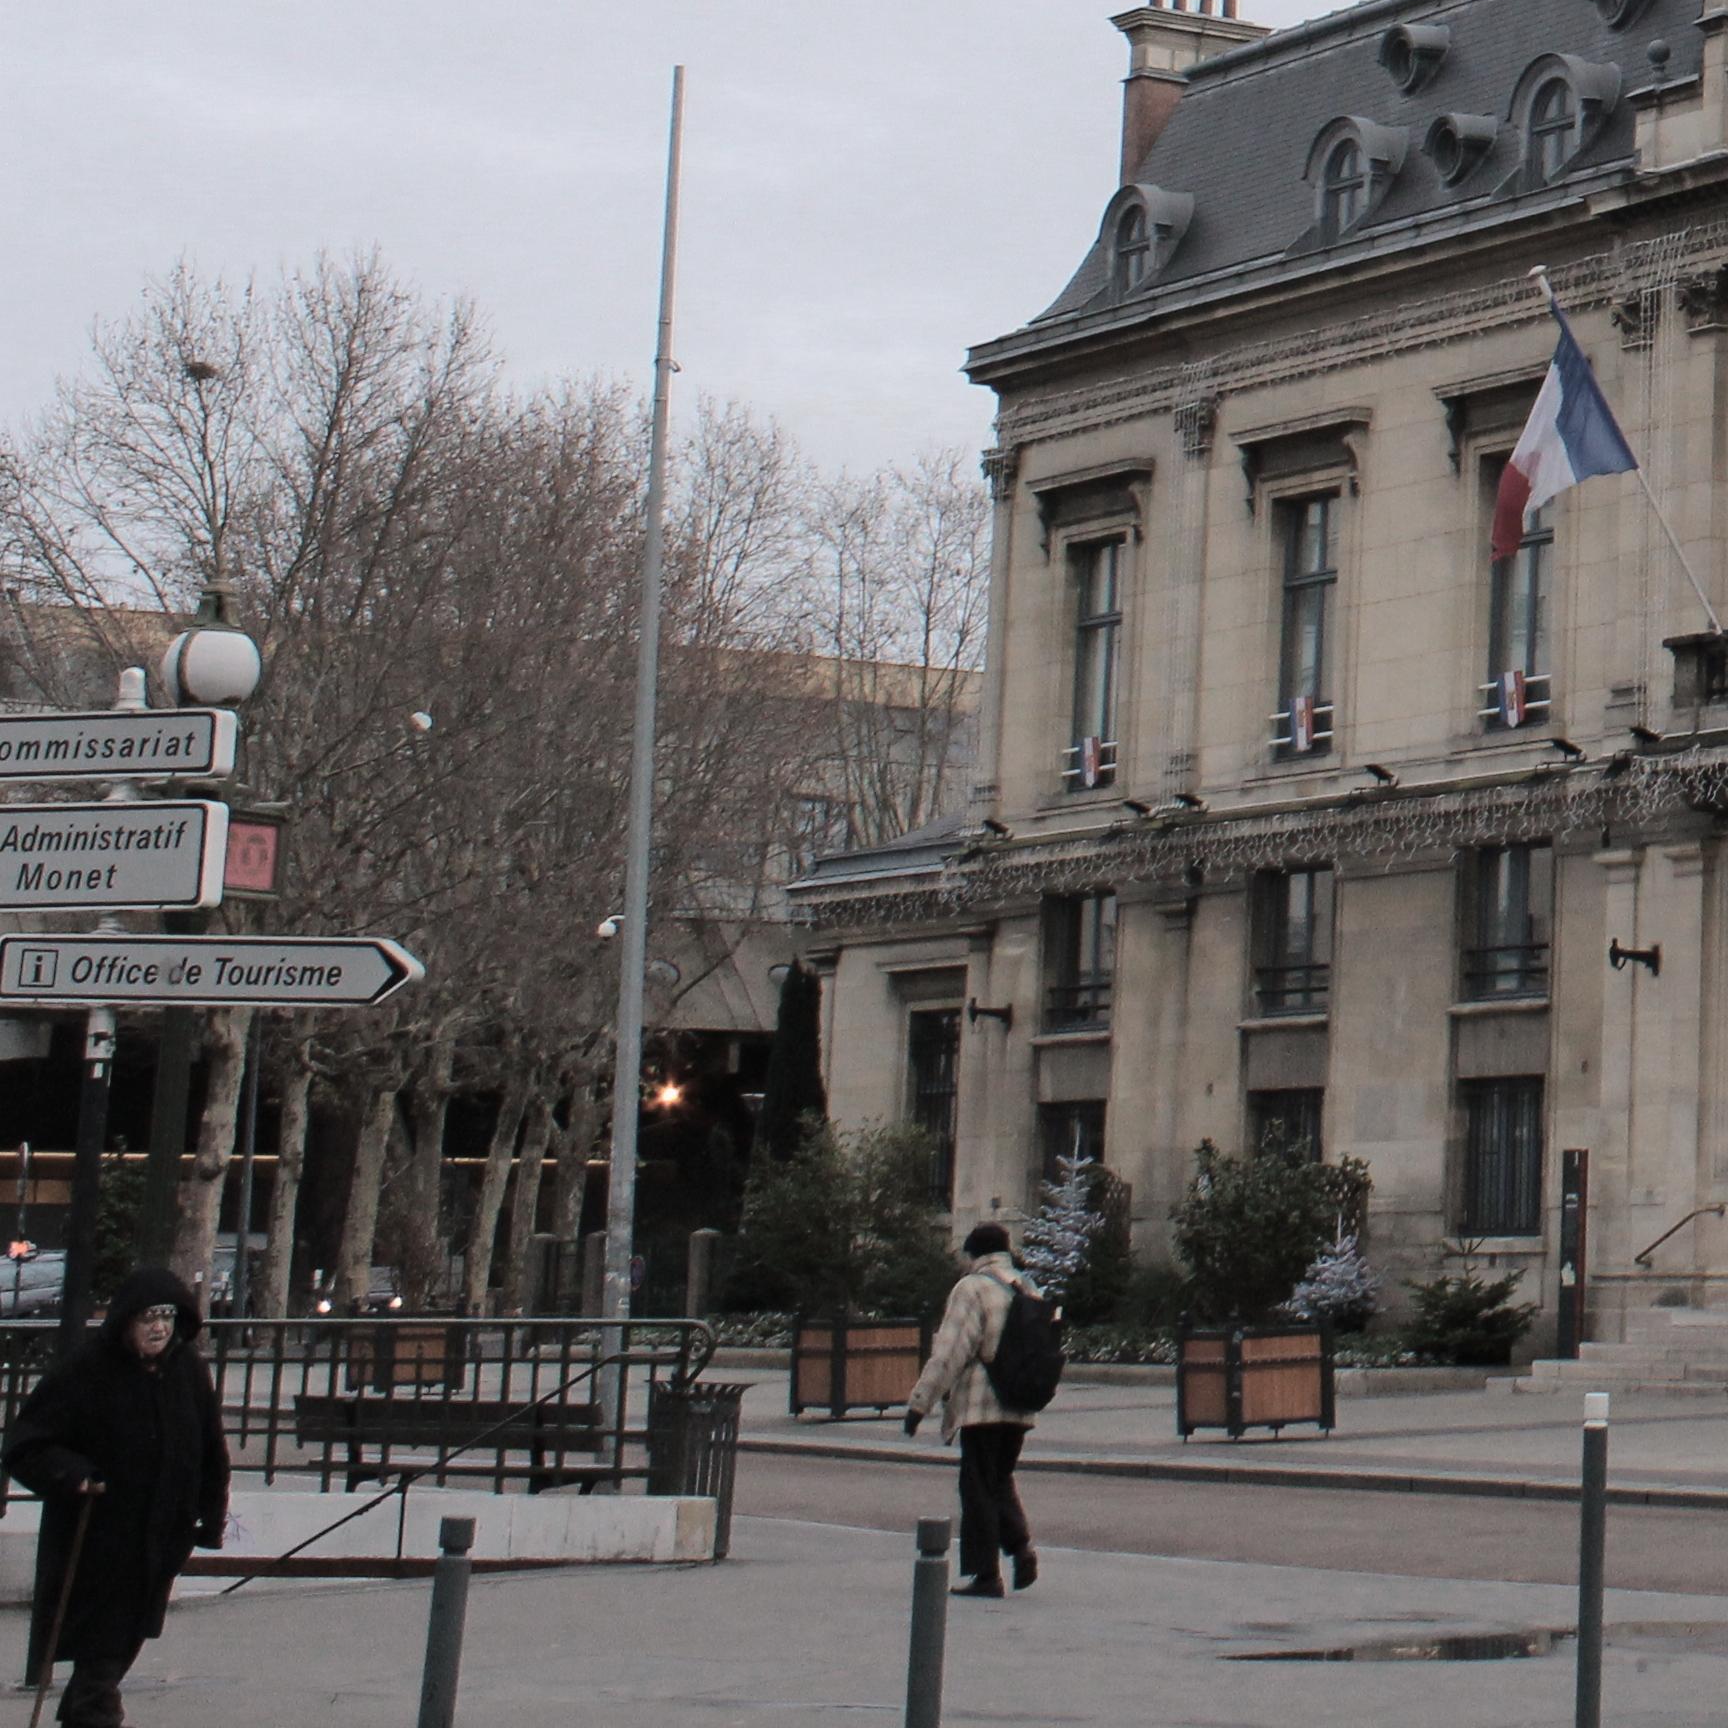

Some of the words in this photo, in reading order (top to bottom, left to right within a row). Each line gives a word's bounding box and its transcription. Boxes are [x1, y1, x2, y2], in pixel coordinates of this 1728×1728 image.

[0, 729, 196, 761] ommissariat
[0, 821, 187, 853] Administratif
[16, 862, 118, 891] Monet
[71, 956, 158, 985] Office
[168, 957, 202, 985] de
[214, 957, 342, 986] Tourisme
